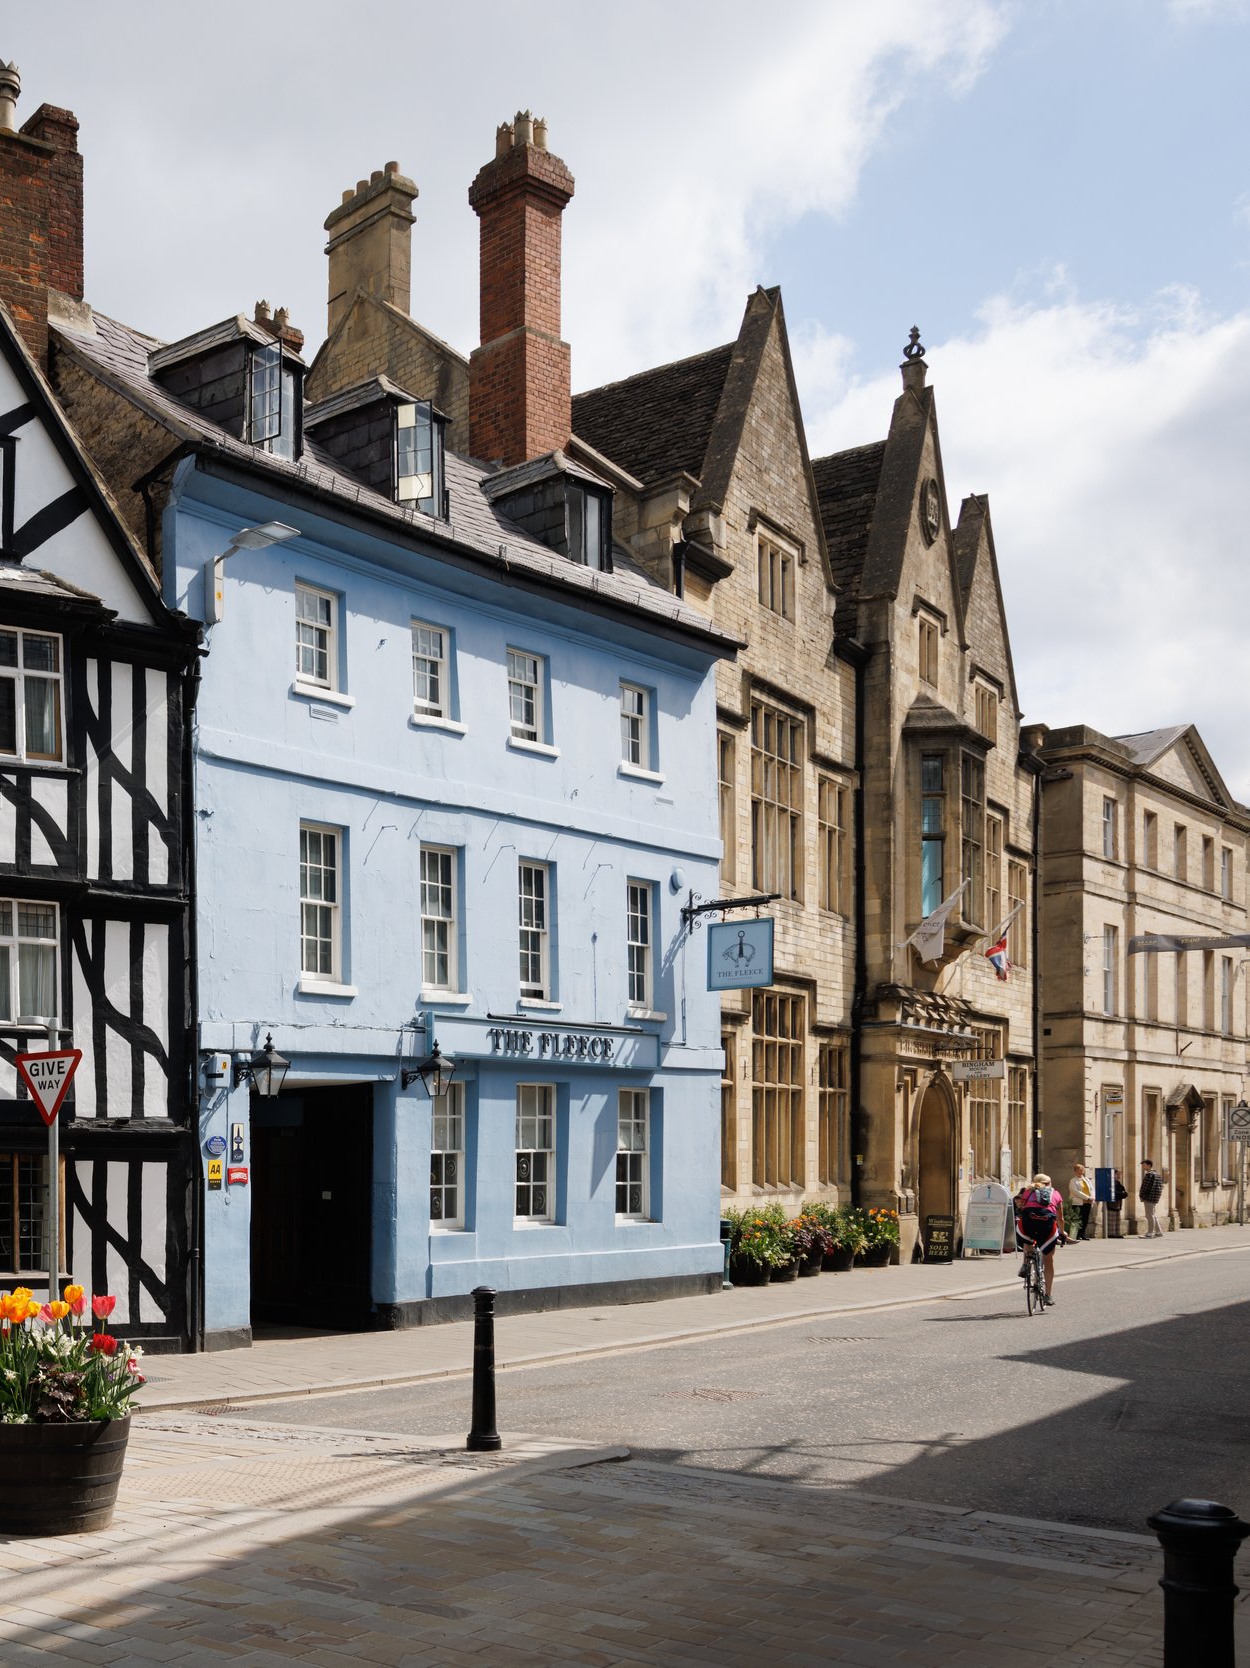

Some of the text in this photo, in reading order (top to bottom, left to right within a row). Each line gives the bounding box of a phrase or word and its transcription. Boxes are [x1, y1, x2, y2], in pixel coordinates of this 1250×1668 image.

[734, 968, 764, 977] FLEECE
[489, 1027, 614, 1059] THE FLEECE
[30, 1061, 66, 1076] GIVE
[38, 1079, 61, 1090] WAY
[210, 1164, 221, 1175] AA
